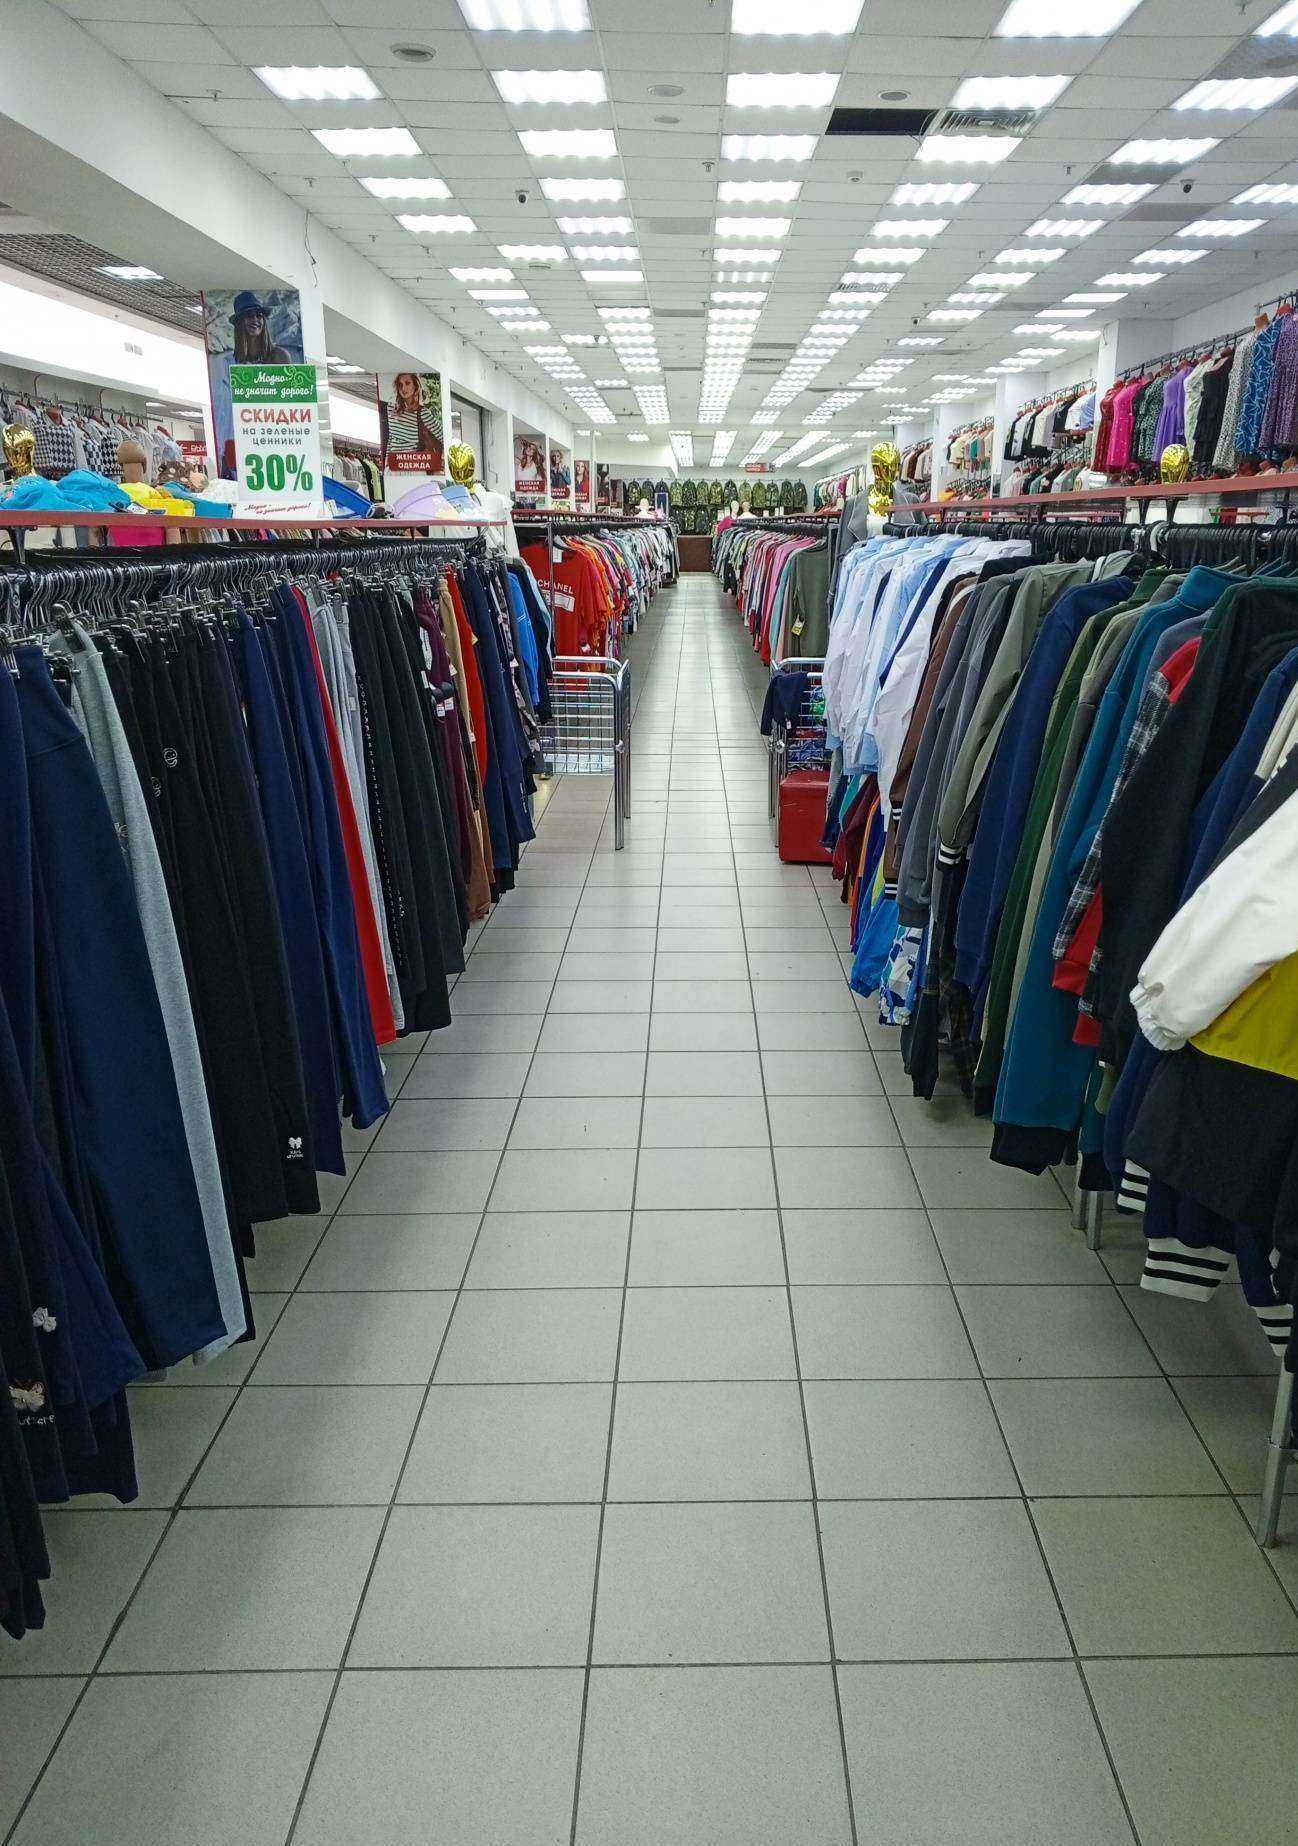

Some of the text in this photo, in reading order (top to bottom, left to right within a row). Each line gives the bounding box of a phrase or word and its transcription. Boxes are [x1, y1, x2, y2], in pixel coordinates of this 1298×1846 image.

[234, 385, 314, 398] не значит дорого!
[240, 408, 312, 425] СКИДКИ
[260, 427, 311, 436] зеленые
[252, 437, 302, 446] ценники
[395, 453, 432, 461] ЖЕНСКАЯ
[398, 462, 431, 470] ОДЕЖДА
[244, 453, 313, 492] 30%
